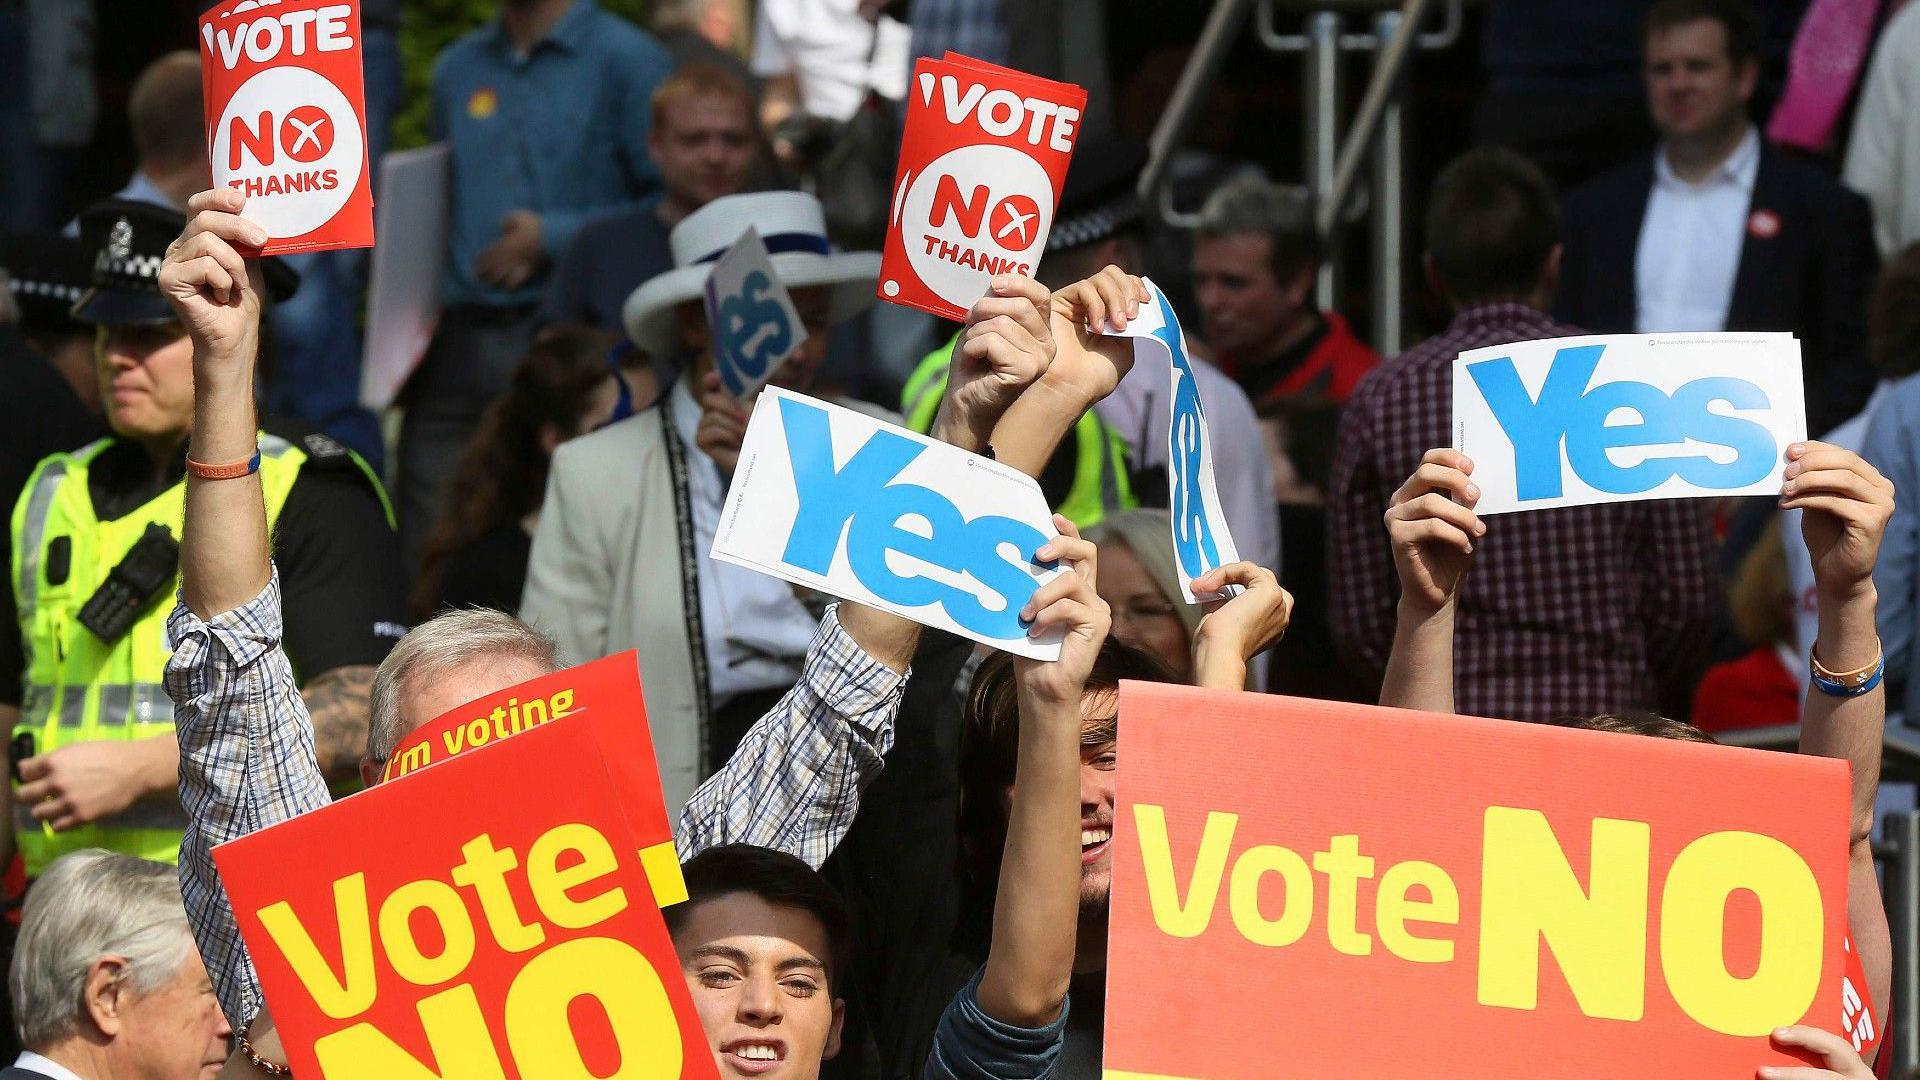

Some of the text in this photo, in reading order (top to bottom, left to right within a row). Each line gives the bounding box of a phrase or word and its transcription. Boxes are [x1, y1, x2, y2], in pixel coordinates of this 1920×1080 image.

[217, 4, 353, 70] VOTE
[941, 75, 1079, 153] VOTE
[228, 169, 338, 198] THANKS
[1465, 344, 1778, 501] Yes
[777, 396, 1059, 640] Yes
[442, 688, 574, 756] voting
[256, 823, 628, 1019] Vote
[1132, 803, 1825, 1037] Vote NO
